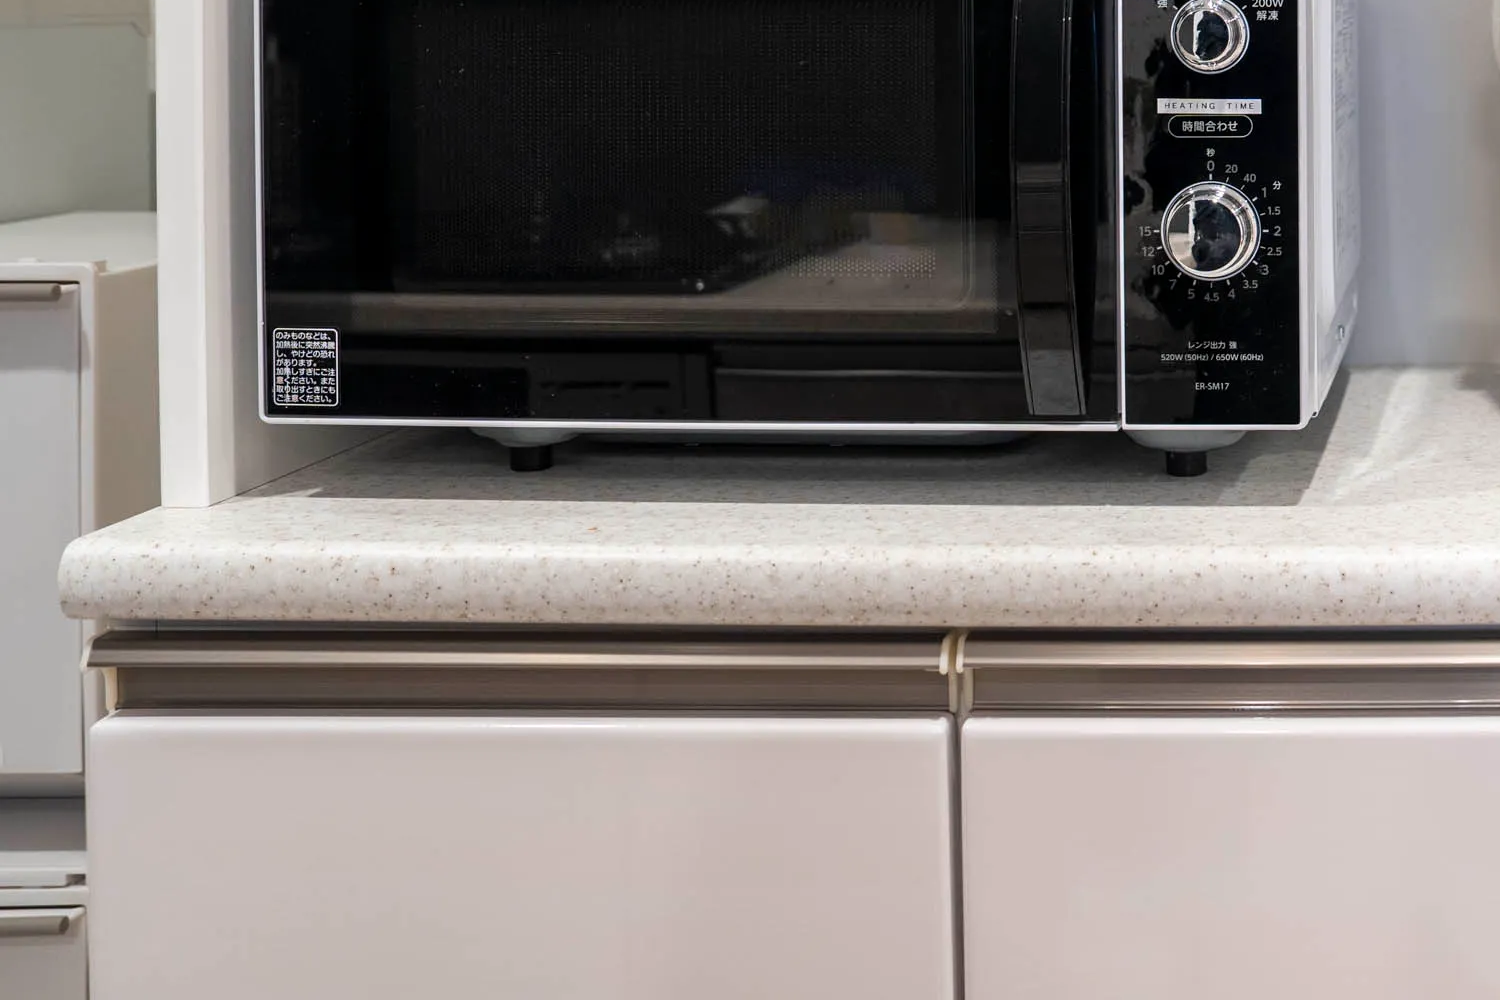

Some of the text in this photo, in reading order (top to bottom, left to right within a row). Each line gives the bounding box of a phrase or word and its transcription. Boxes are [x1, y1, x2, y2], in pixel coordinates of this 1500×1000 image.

[1256, 10, 1279, 21] 解凍
[1164, 102, 1255, 110] HEATING TIME
[1182, 120, 1238, 132] 時間合わせ
[1206, 148, 1216, 157] 秒
[1207, 160, 1215, 171] 0
[1225, 164, 1238, 174] 20
[1243, 173, 1257, 183] 40
[1272, 180, 1282, 190] 分
[1261, 187, 1267, 197] 1
[1267, 206, 1281, 216] 1.5
[1139, 226, 1151, 236] 15
[1274, 226, 1282, 236] 2
[1142, 247, 1155, 257] 12
[1267, 246, 1282, 256] 2.5
[1152, 264, 1165, 275] 10
[1261, 265, 1270, 275] 3
[1169, 279, 1177, 289] 7
[1243, 279, 1258, 289] 3.5
[1187, 289, 1195, 299] 5
[1204, 292, 1219, 301] 4.5
[1228, 289, 1236, 299] 4
[275, 332, 332, 340] のみものなどは、
[1188, 341, 1226, 349] レンジ出力
[1184, 353, 1209, 361] (50Hz)
[1240, 353, 1264, 361] (60Hz)
[276, 358, 317, 367] があります。
[1195, 382, 1230, 391] ER-SM17
